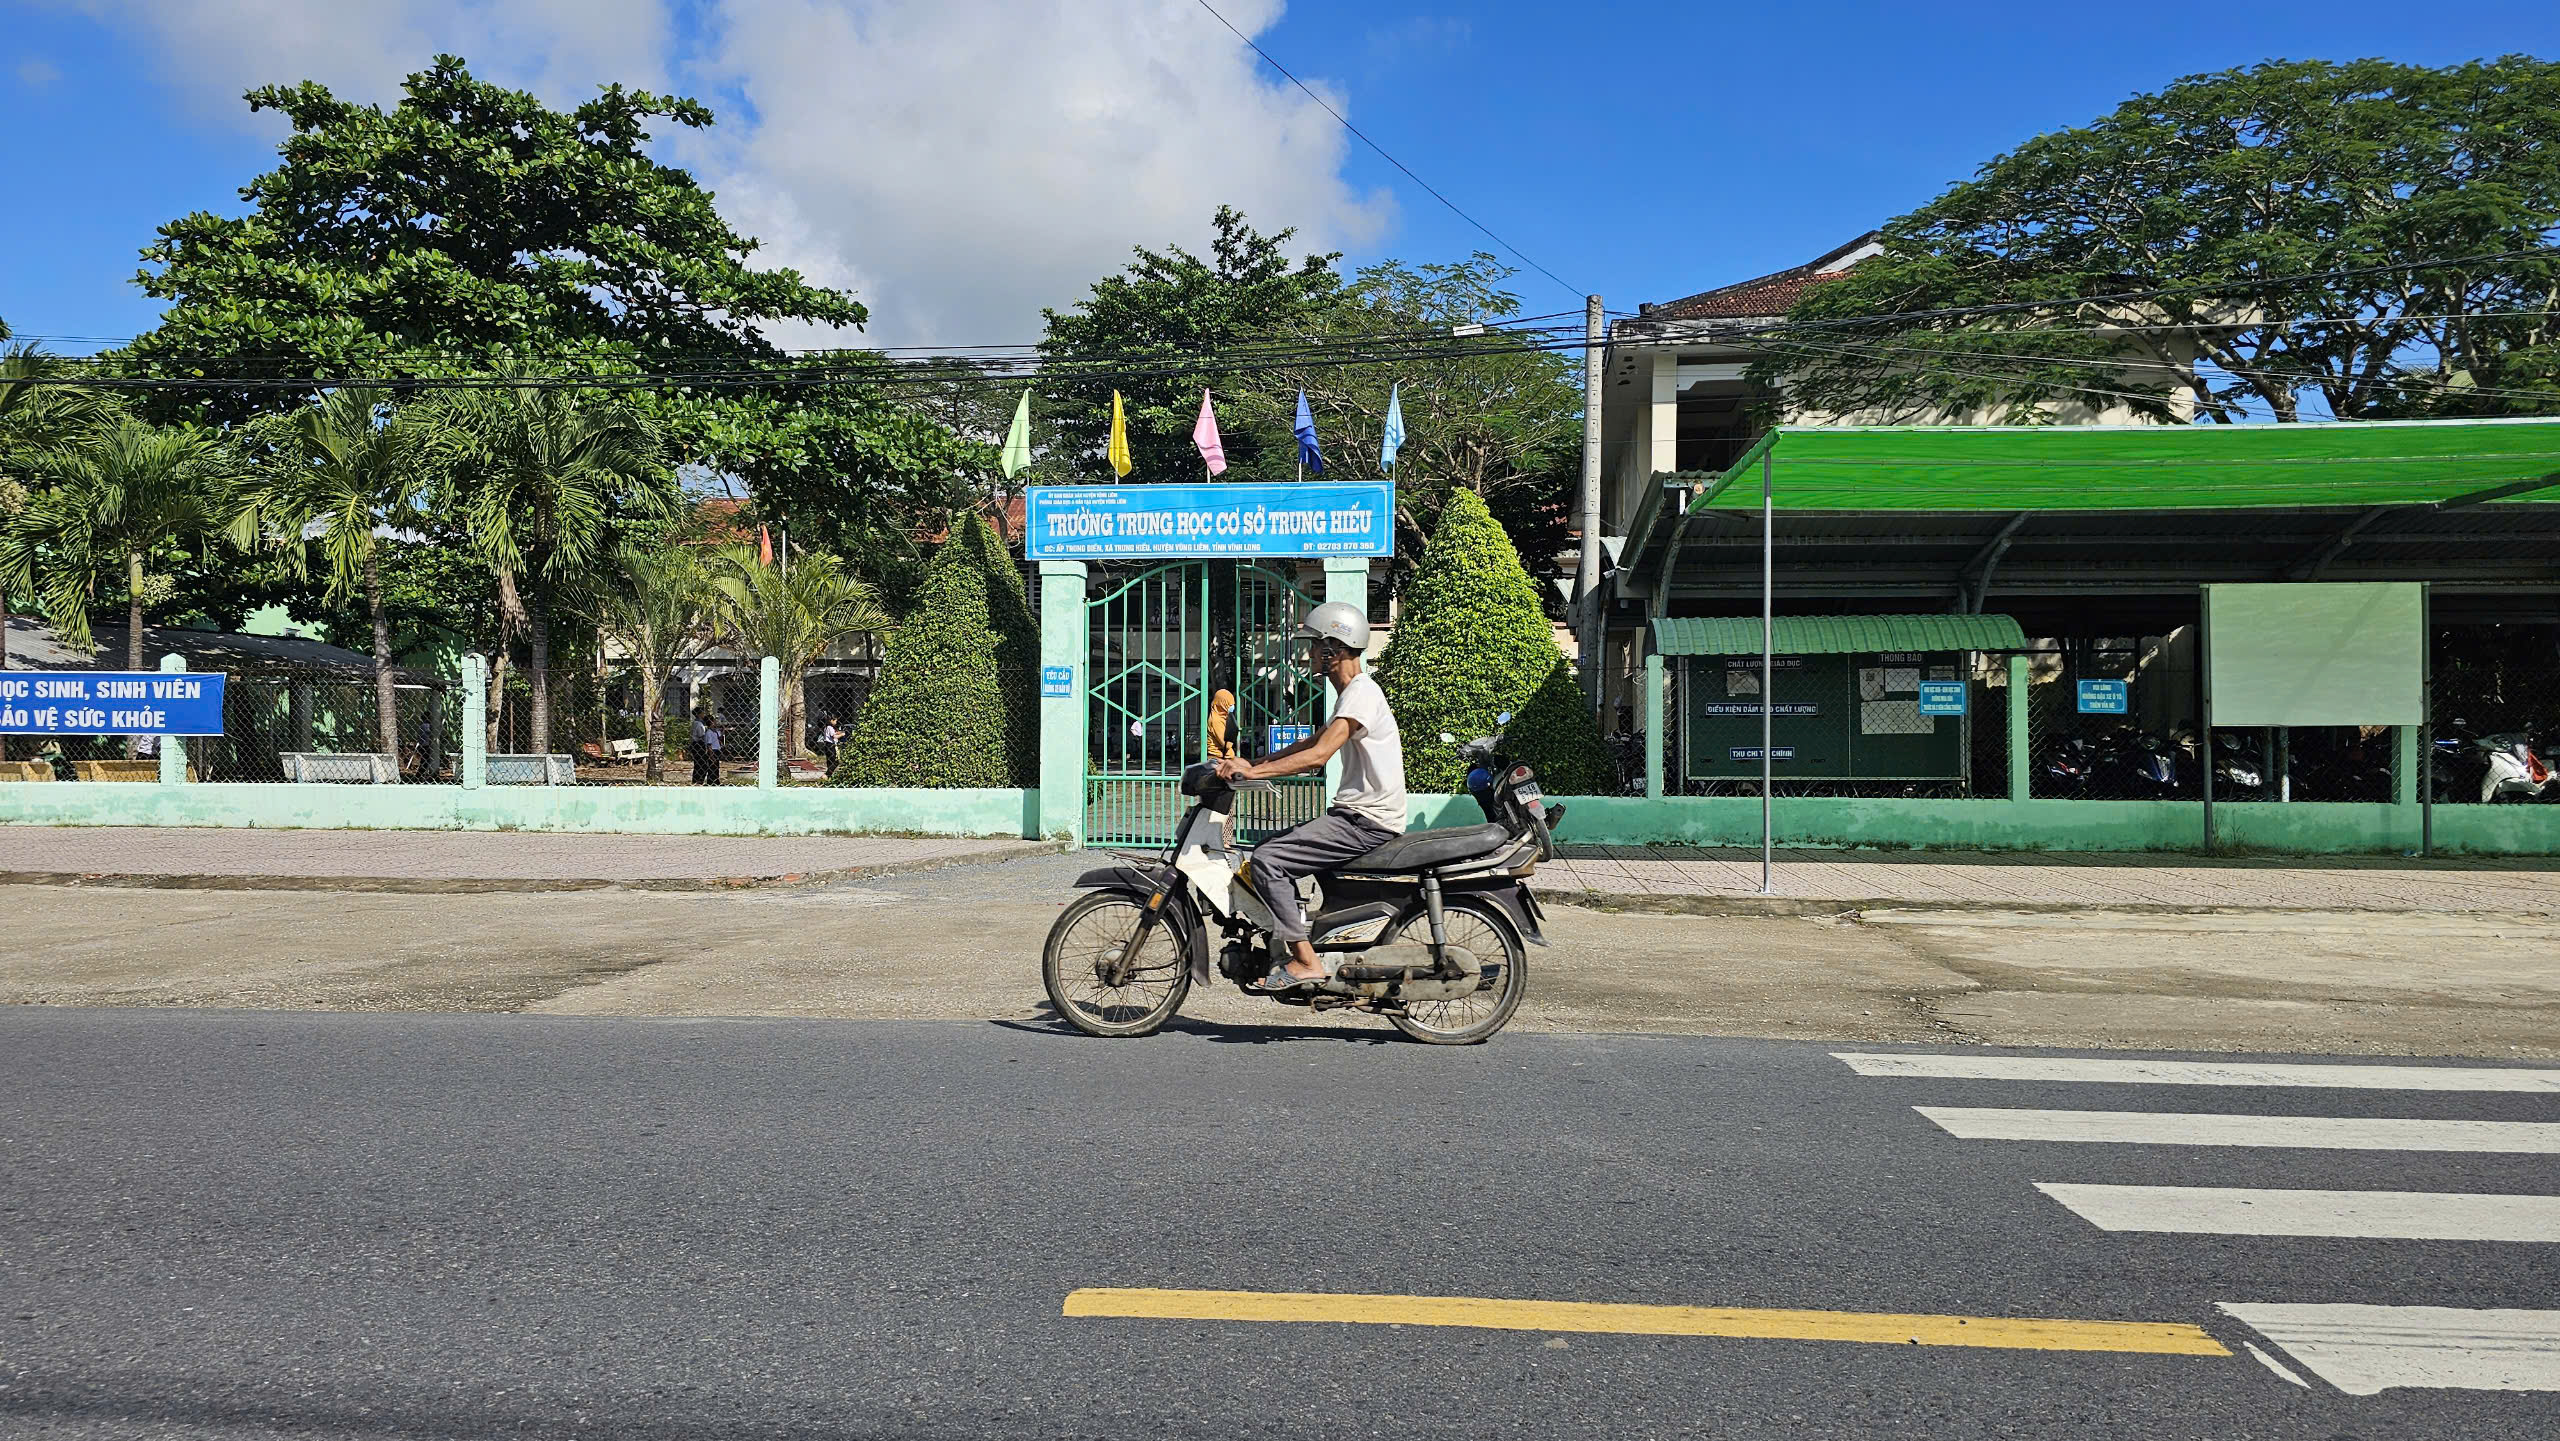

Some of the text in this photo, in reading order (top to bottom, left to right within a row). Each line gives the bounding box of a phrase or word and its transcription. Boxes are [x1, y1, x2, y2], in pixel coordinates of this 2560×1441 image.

[1047, 501, 1372, 540] TRƯỜNG TRUNG HỌC CƠ SỞ TRUNG HIẾU
[35, 681, 90, 700] SINH,
[96, 681, 146, 698] SINH
[152, 678, 200, 699] VIÊN
[0, 704, 166, 730] ẢO VỆ SỨC KHỎE
